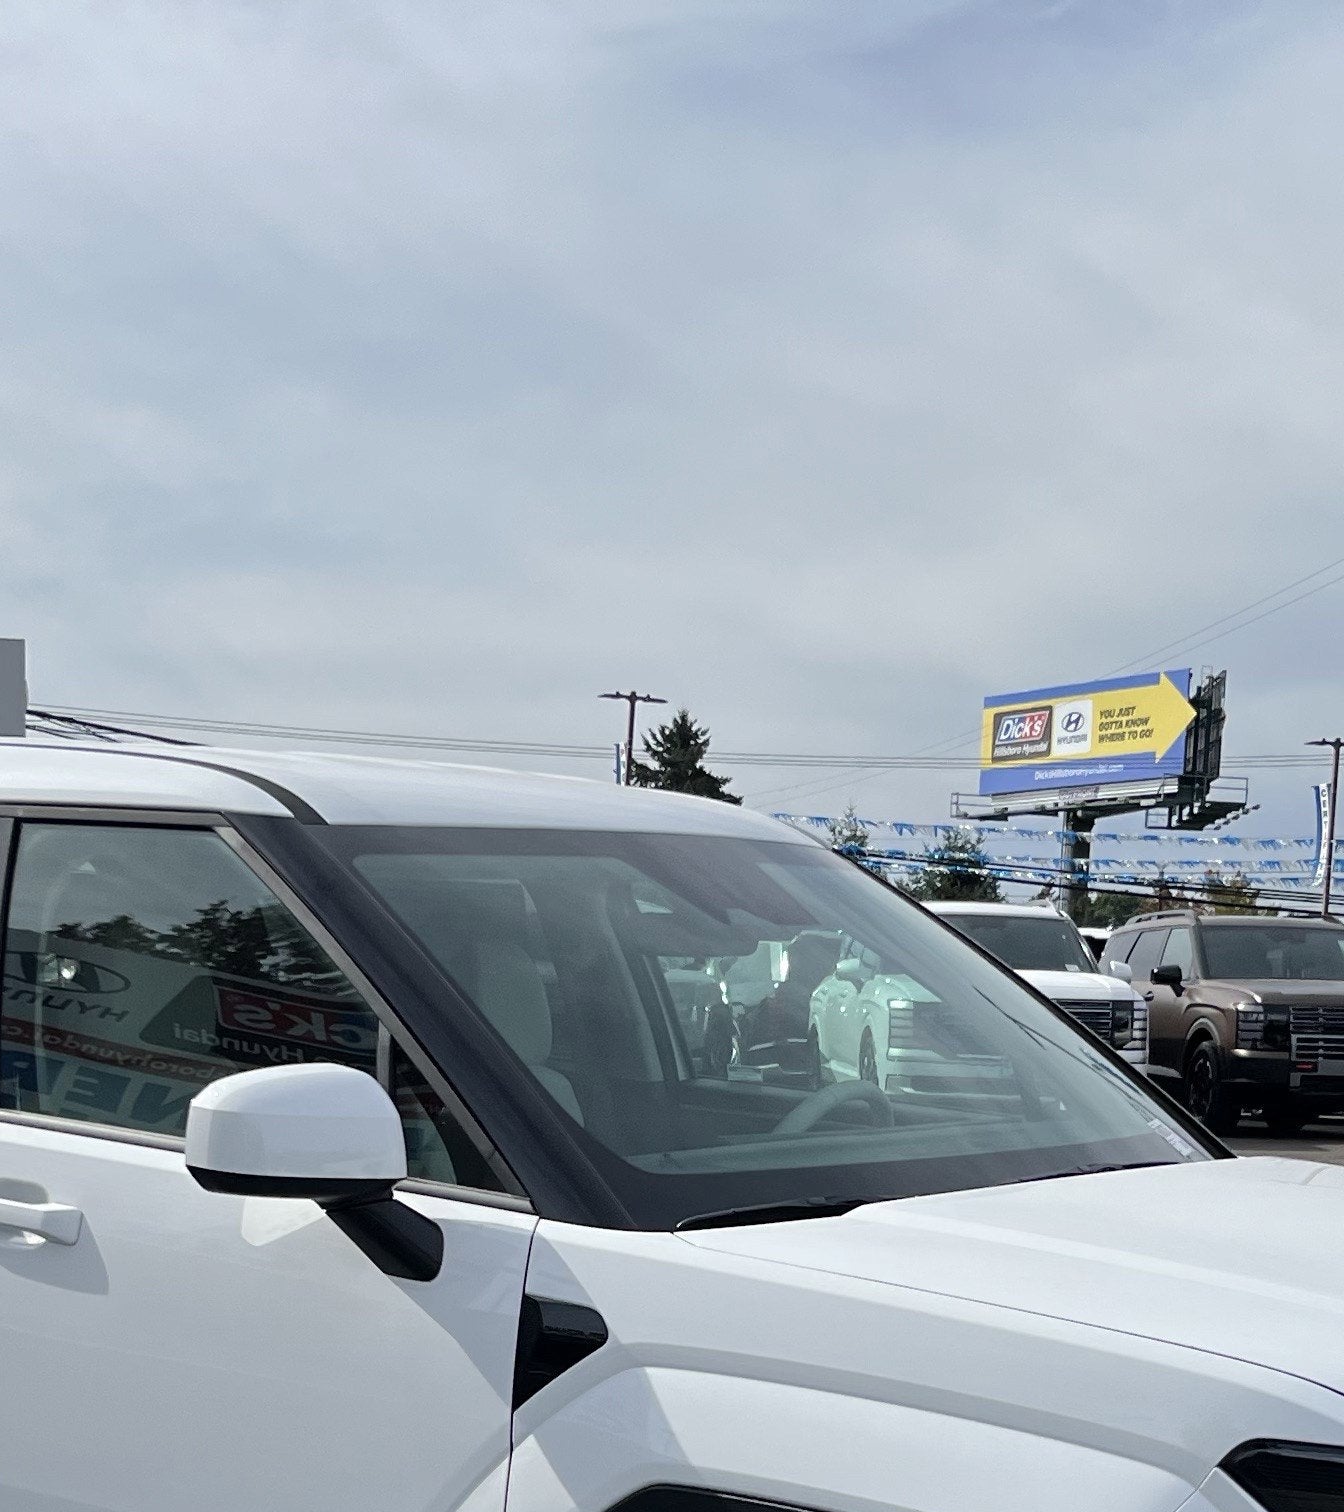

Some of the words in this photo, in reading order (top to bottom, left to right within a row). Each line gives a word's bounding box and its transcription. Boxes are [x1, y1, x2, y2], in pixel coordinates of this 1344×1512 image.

[1099, 708, 1116, 720] YOU
[1116, 706, 1137, 718] JUST
[1000, 715, 1043, 740] Dick's
[1098, 720, 1124, 732] GOTTA
[1125, 716, 1151, 728] KNOW
[1098, 732, 1126, 743] WHERE
[1127, 730, 1138, 740] TO
[1139, 727, 1155, 739] GO!
